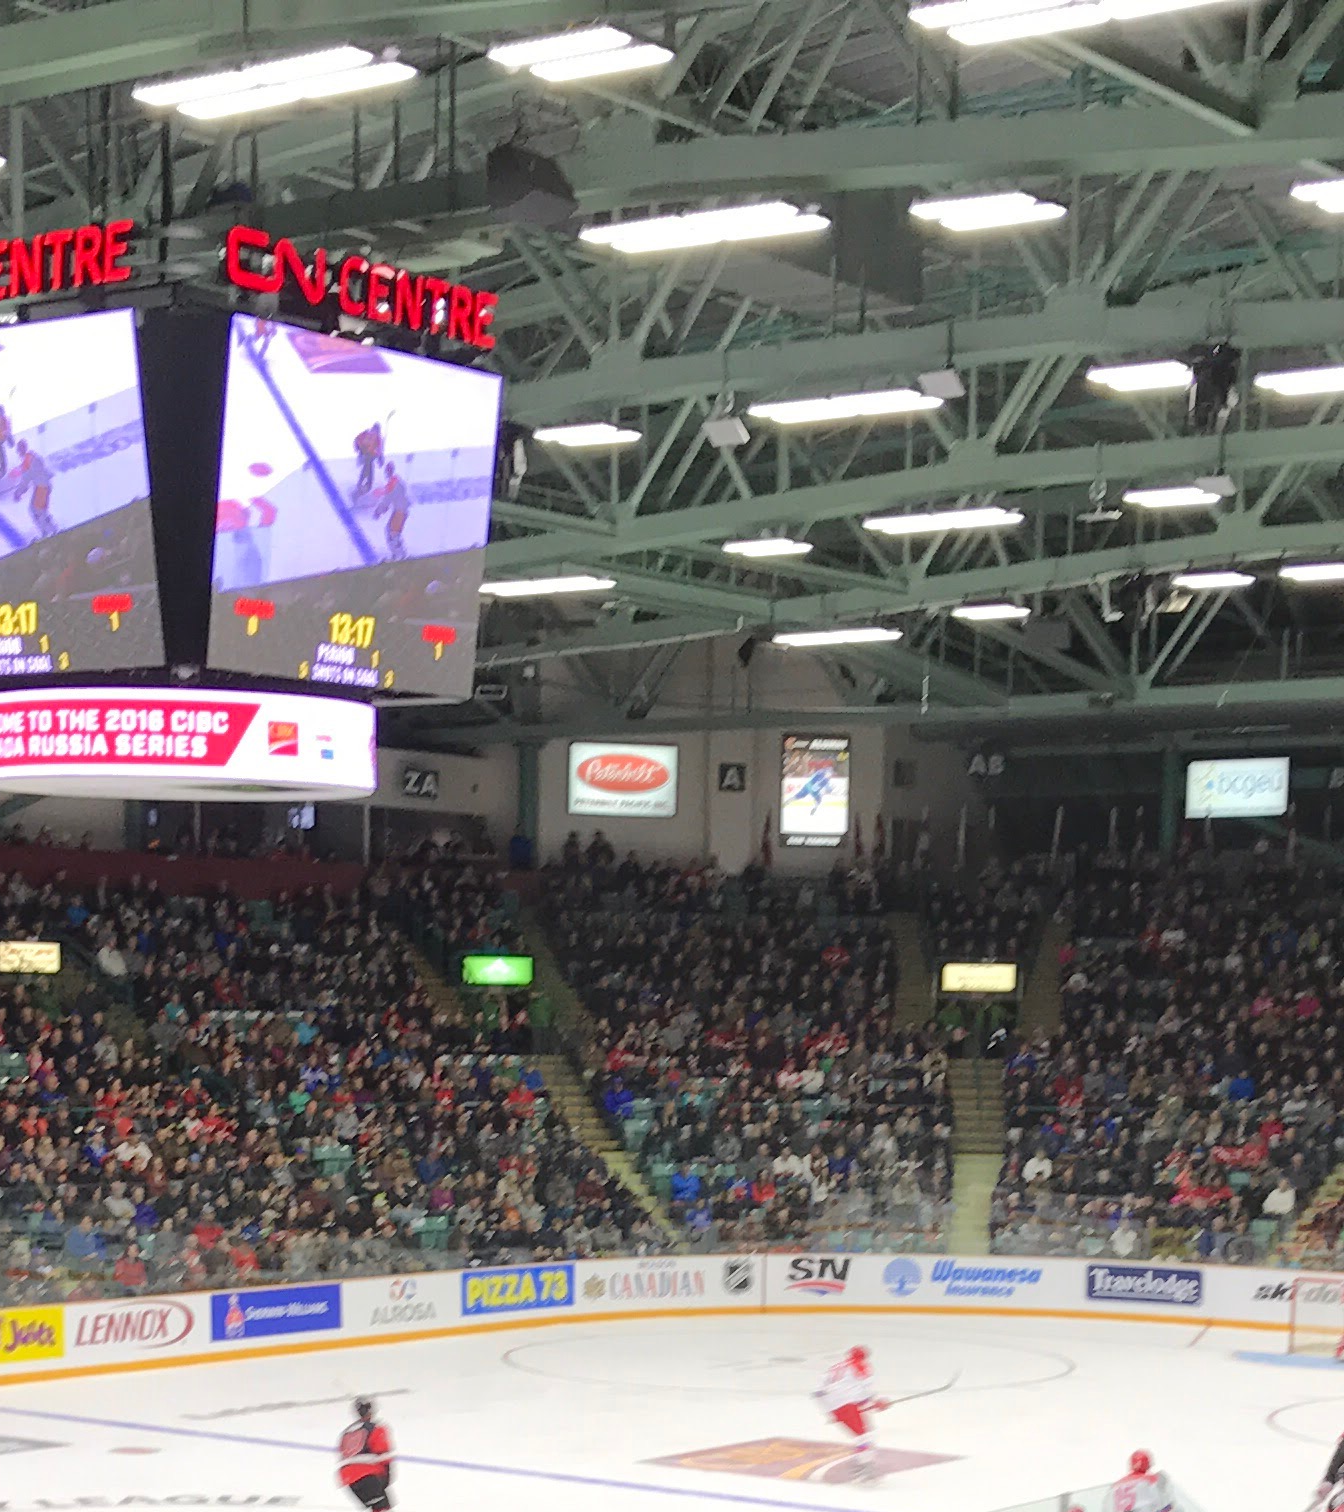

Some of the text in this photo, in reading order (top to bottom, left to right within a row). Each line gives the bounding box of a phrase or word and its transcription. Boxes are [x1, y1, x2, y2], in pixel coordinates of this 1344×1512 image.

[226, 225, 499, 350] CN CENTRE
[327, 612, 376, 648] 13:17
[27, 709, 52, 732] TO
[56, 708, 100, 732] THE
[105, 708, 165, 733] 2016
[170, 709, 229, 735] CIBC
[27, 733, 108, 758] RUSSIA
[115, 733, 208, 759] SERIES
[721, 766, 740, 791] A
[967, 753, 1006, 777] AB
[404, 770, 439, 798] ZA
[788, 1257, 852, 1281] SN
[930, 1259, 1044, 1285] Wawanesa
[465, 1268, 570, 1309] PIZZA 73
[608, 1270, 706, 1300] CANADIAN
[1089, 1267, 1201, 1304] Travelodge
[74, 1307, 173, 1347] LENNOX
[73, 1494, 305, 1508] LEAGUE
